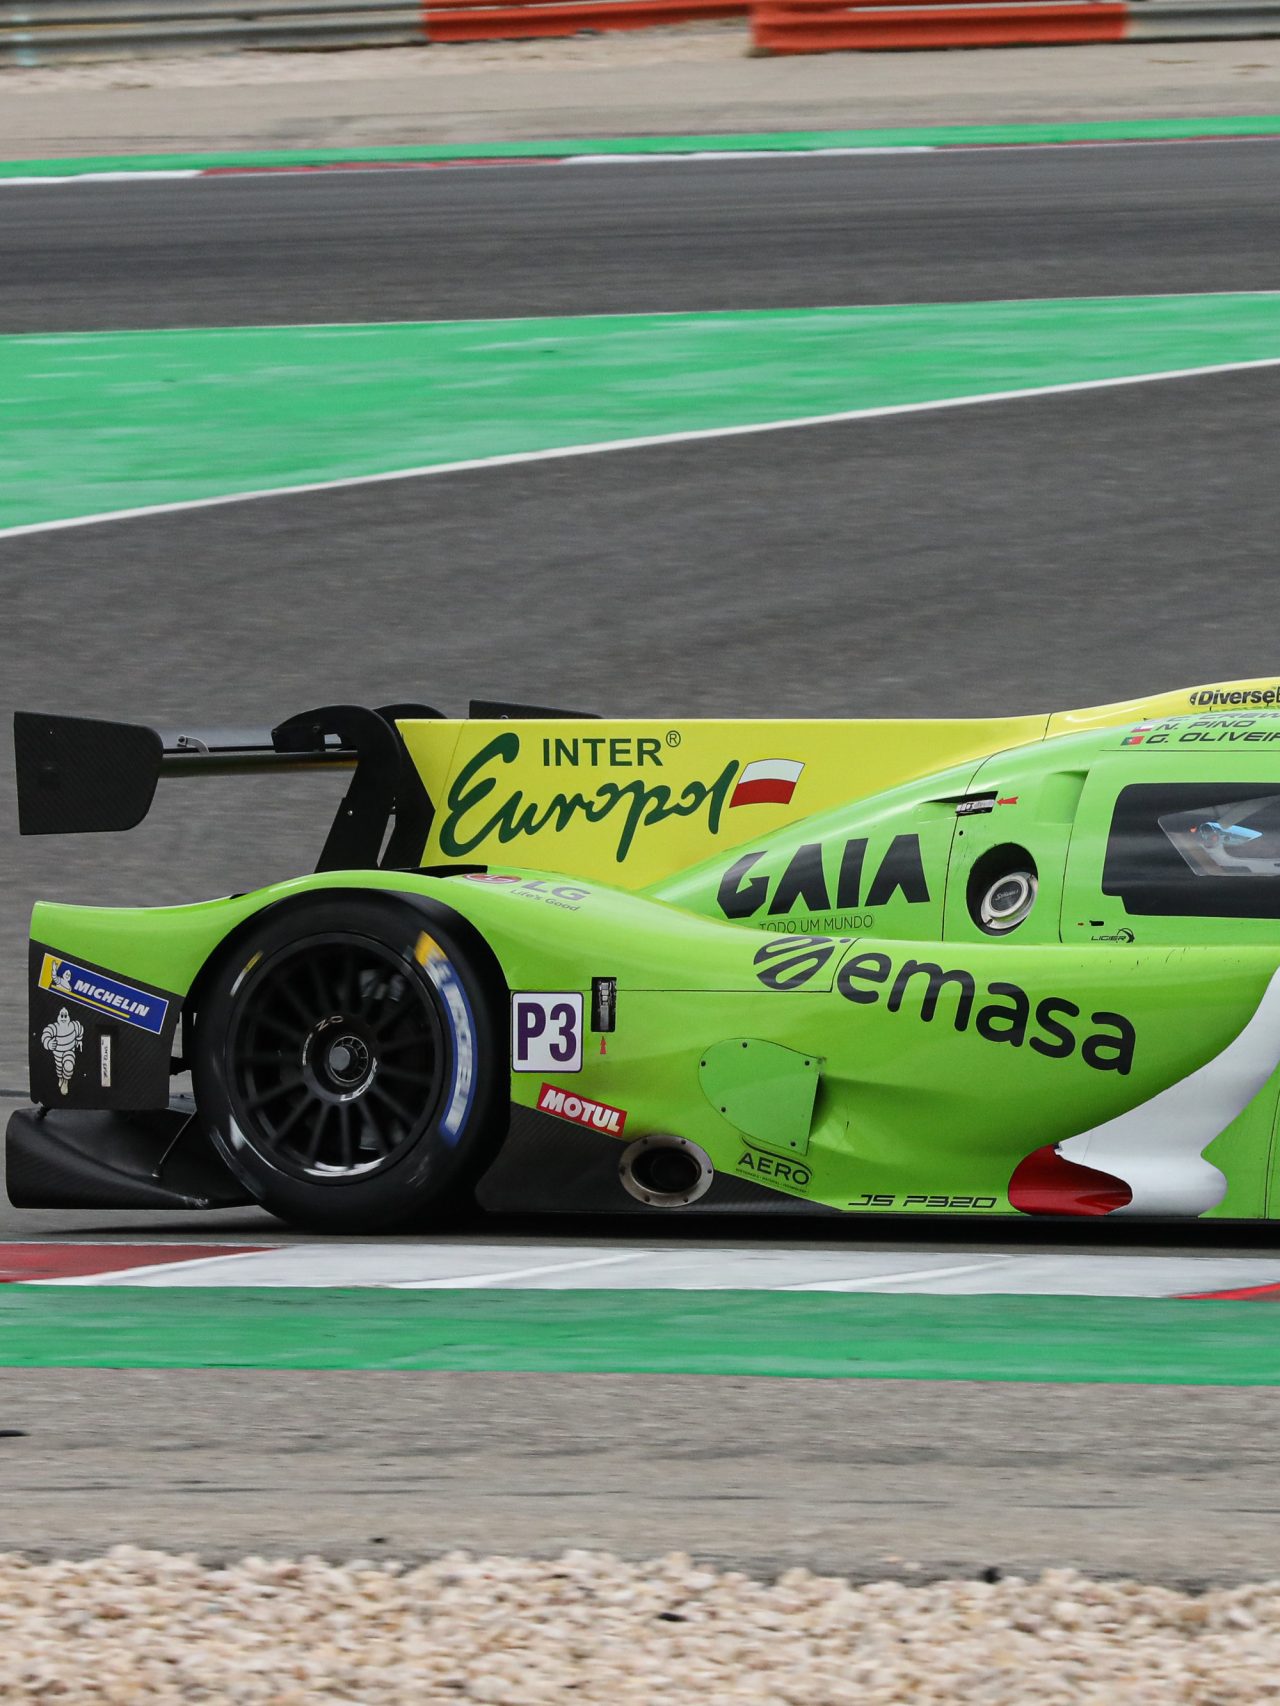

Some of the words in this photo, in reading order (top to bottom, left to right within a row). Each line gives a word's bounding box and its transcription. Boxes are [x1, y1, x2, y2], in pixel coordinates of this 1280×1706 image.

[1146, 732, 1170, 744] G.
[1154, 722, 1179, 731] N.
[1187, 720, 1257, 730] PINO
[439, 732, 740, 863] Europol
[521, 880, 592, 901] LG
[716, 833, 931, 919] GAIA
[545, 898, 581, 911] Good
[800, 919, 820, 933] UM
[823, 914, 873, 931] MUNDO
[73, 979, 150, 1017] MICHELIN
[836, 951, 1136, 1076] emasa
[516, 1001, 578, 1062] P3
[540, 1088, 621, 1133] MOTUL
[737, 1152, 810, 1186] AERO
[847, 1194, 896, 1207] JS
[902, 1195, 998, 1209] P320
